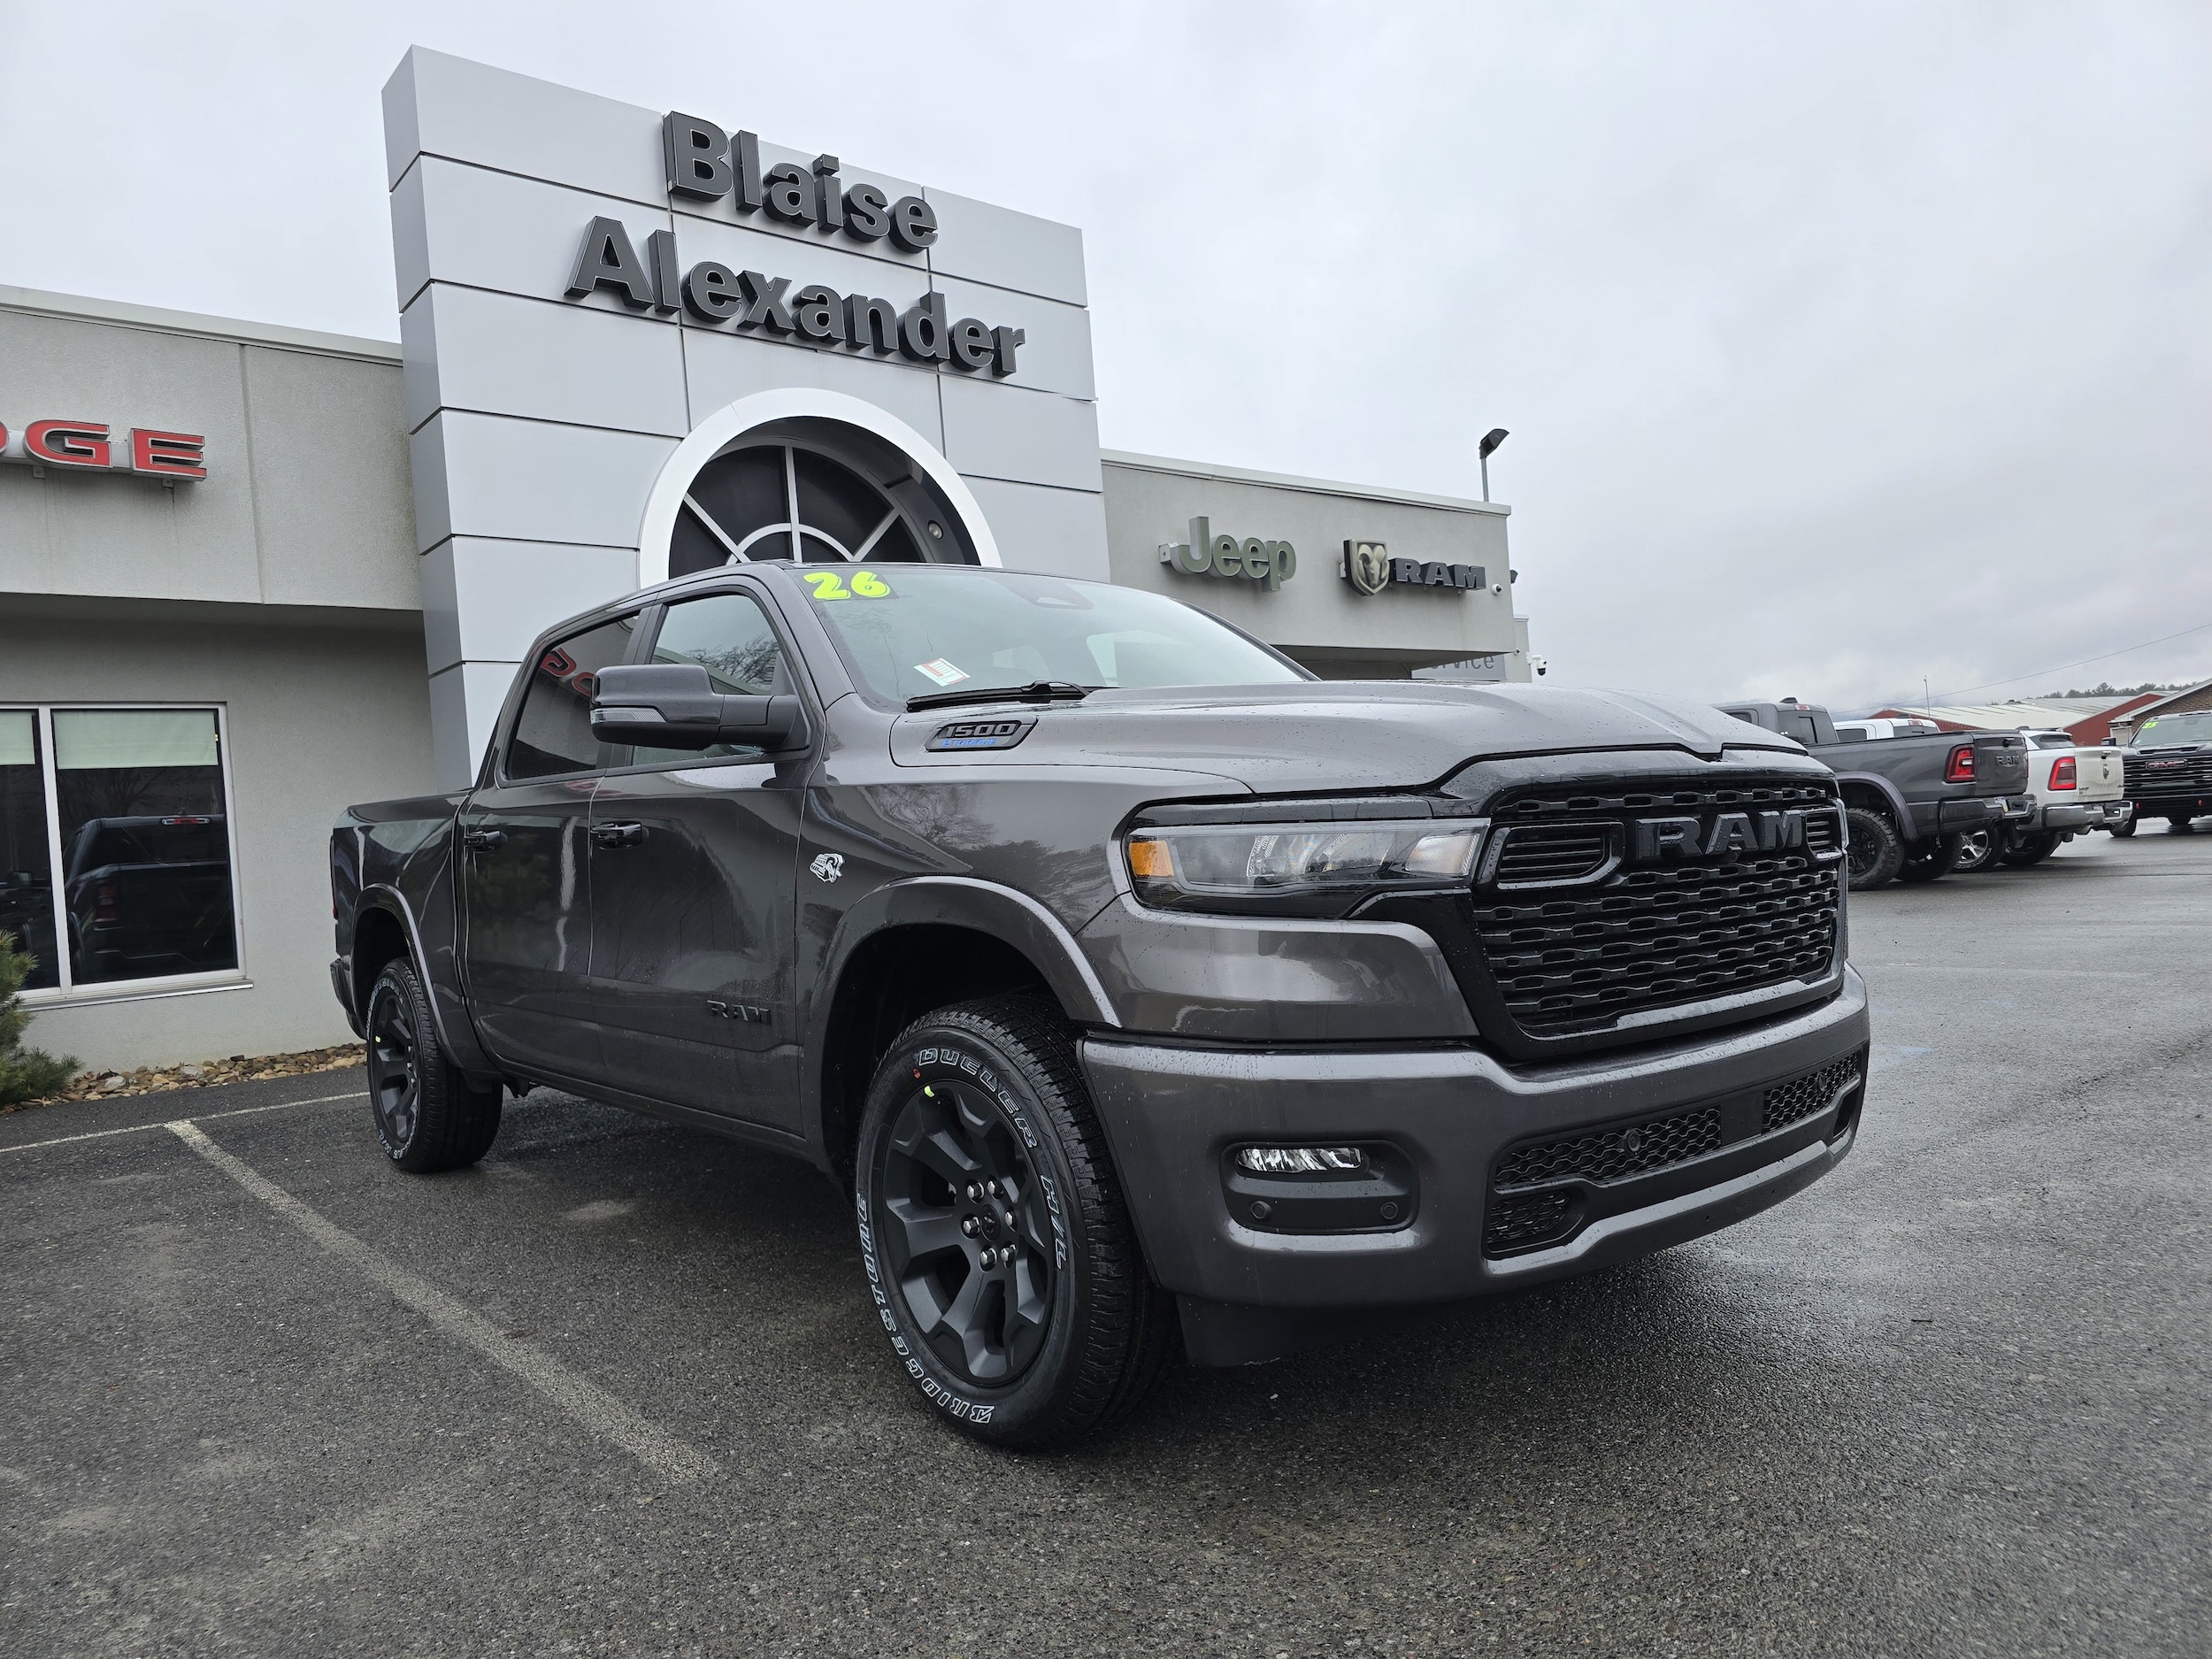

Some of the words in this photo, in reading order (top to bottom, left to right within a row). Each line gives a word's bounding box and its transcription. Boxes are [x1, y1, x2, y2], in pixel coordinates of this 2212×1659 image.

[663, 111, 940, 254] Blaise
[565, 215, 1026, 378] Alexander
[0, 419, 207, 481] GE
[1171, 516, 1297, 591] Jeep
[1389, 557, 1486, 590] RAM
[803, 571, 890, 601] 26
[943, 723, 1018, 737] 1500
[1995, 756, 2019, 766] RAM
[1637, 810, 1803, 859] RAM
[706, 1000, 772, 1025] RAM
[918, 1048, 1038, 1148] DUELER
[856, 1193, 995, 1424] BRIDGESTONE
